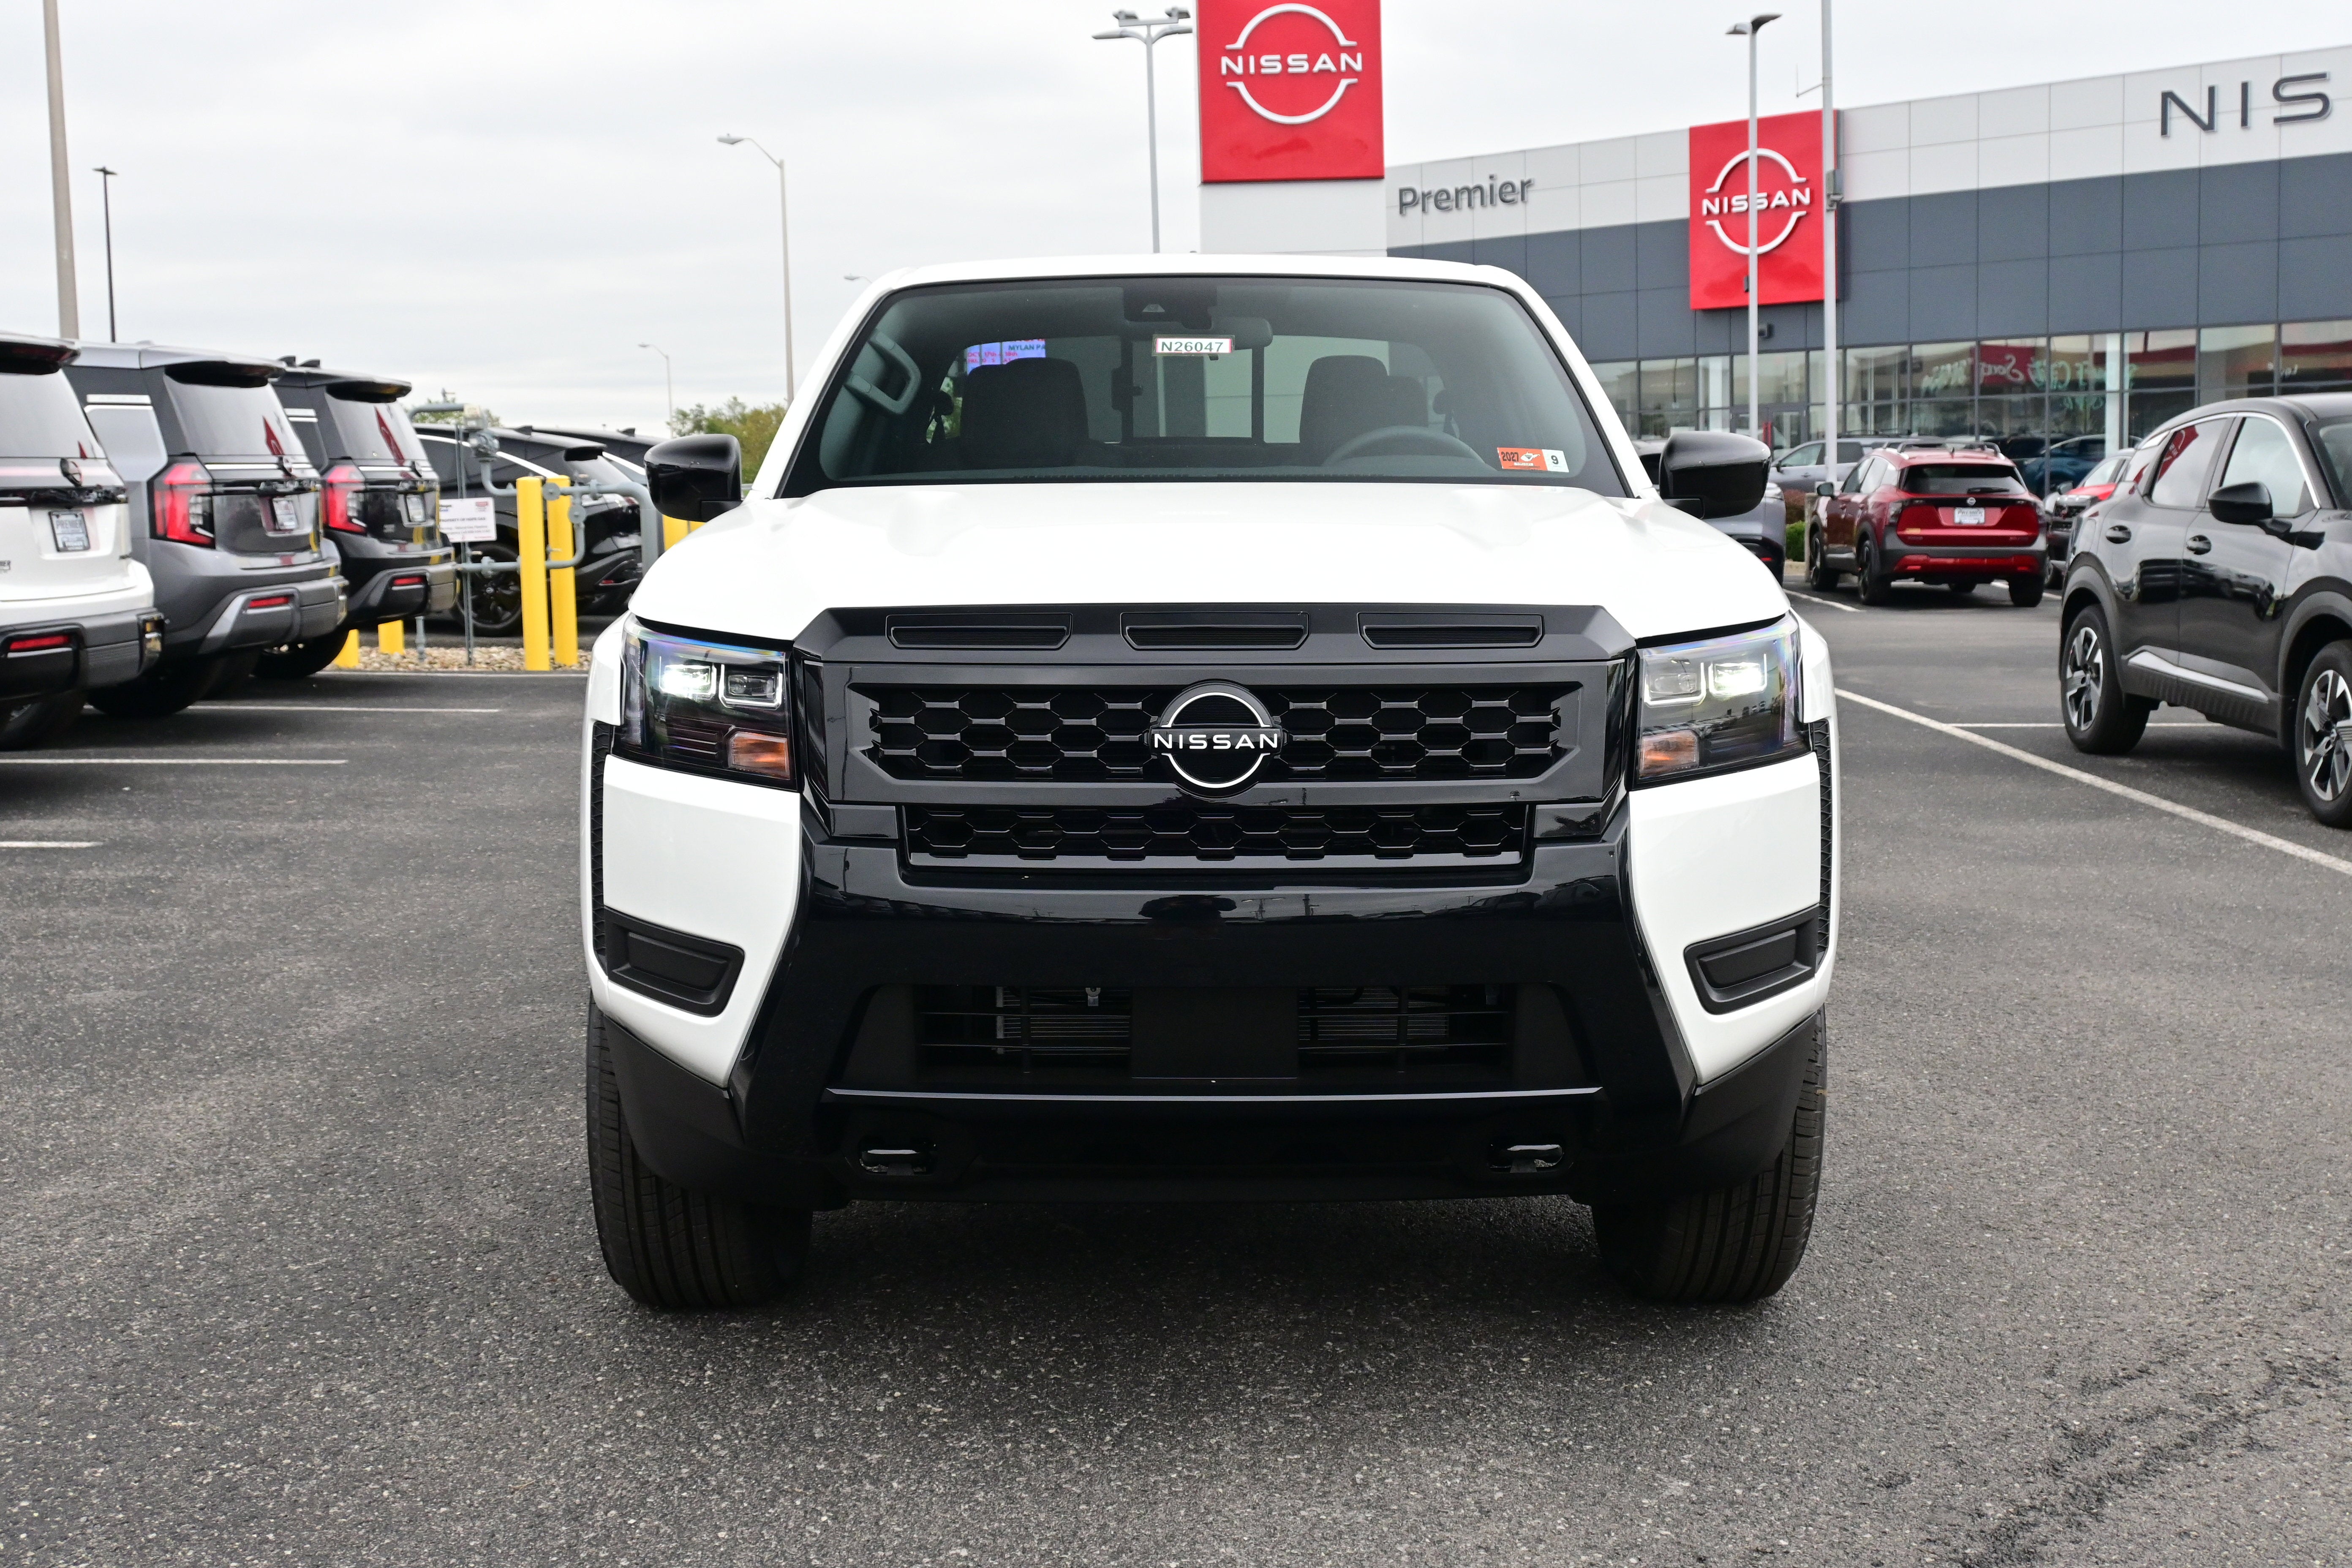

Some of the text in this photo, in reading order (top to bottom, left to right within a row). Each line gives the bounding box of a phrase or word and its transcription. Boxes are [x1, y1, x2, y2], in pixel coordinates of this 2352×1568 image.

[1221, 52, 1362, 76] NISSAN
[2161, 71, 2332, 137] NIS
[1399, 174, 1533, 215] Premier
[1702, 187, 1810, 216] NISSAN
[1161, 342, 1223, 352] N26047
[1501, 452, 1519, 462] 2027
[1551, 455, 1559, 465] 9
[1154, 733, 1278, 749] NISSAN
